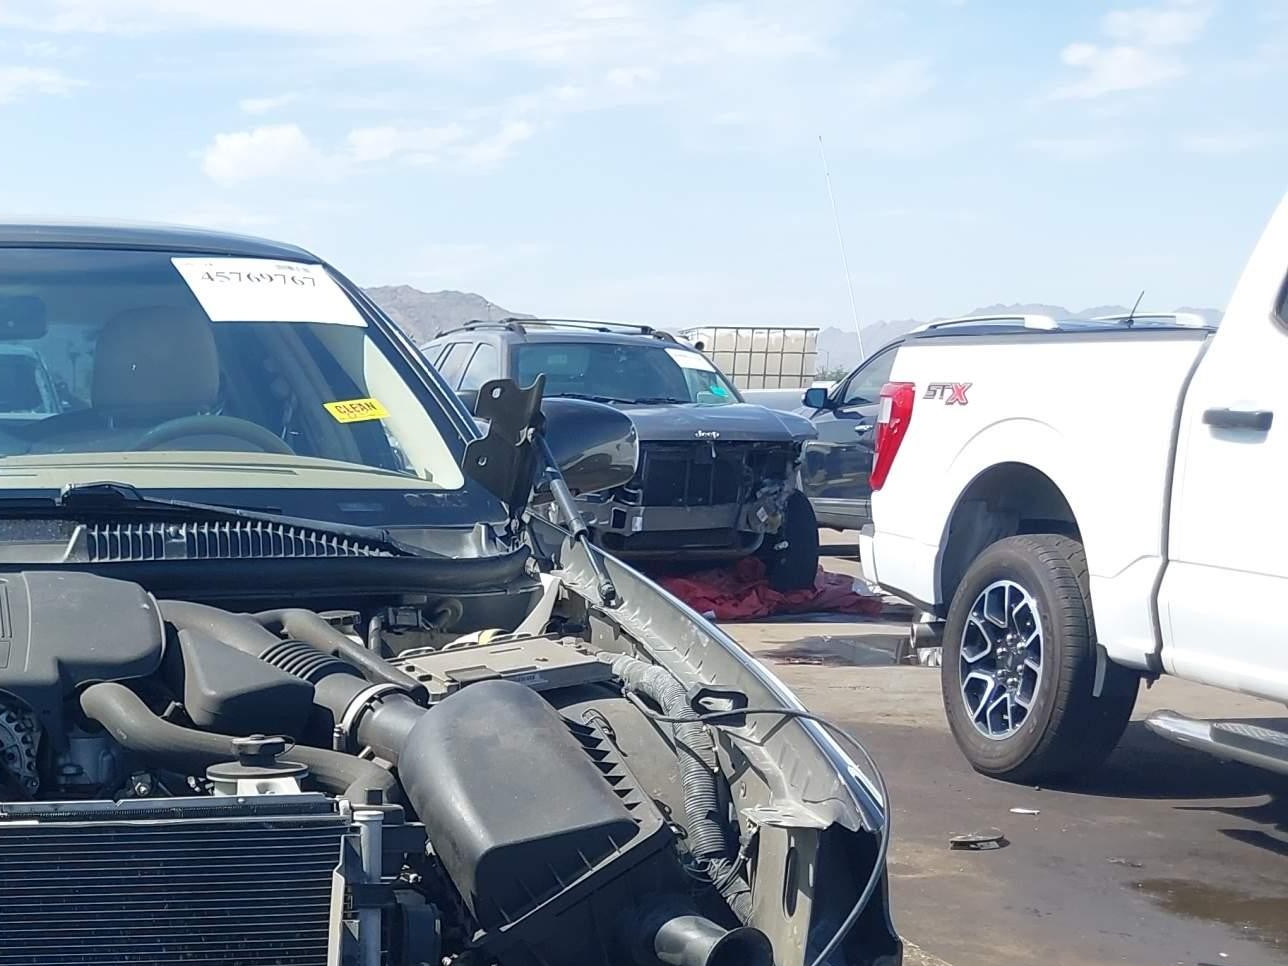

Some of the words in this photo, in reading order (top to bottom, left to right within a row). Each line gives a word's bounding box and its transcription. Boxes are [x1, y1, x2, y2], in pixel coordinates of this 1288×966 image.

[922, 382, 973, 406] STX
[335, 402, 377, 414] CLEAN
[694, 430, 720, 440] Jeep
